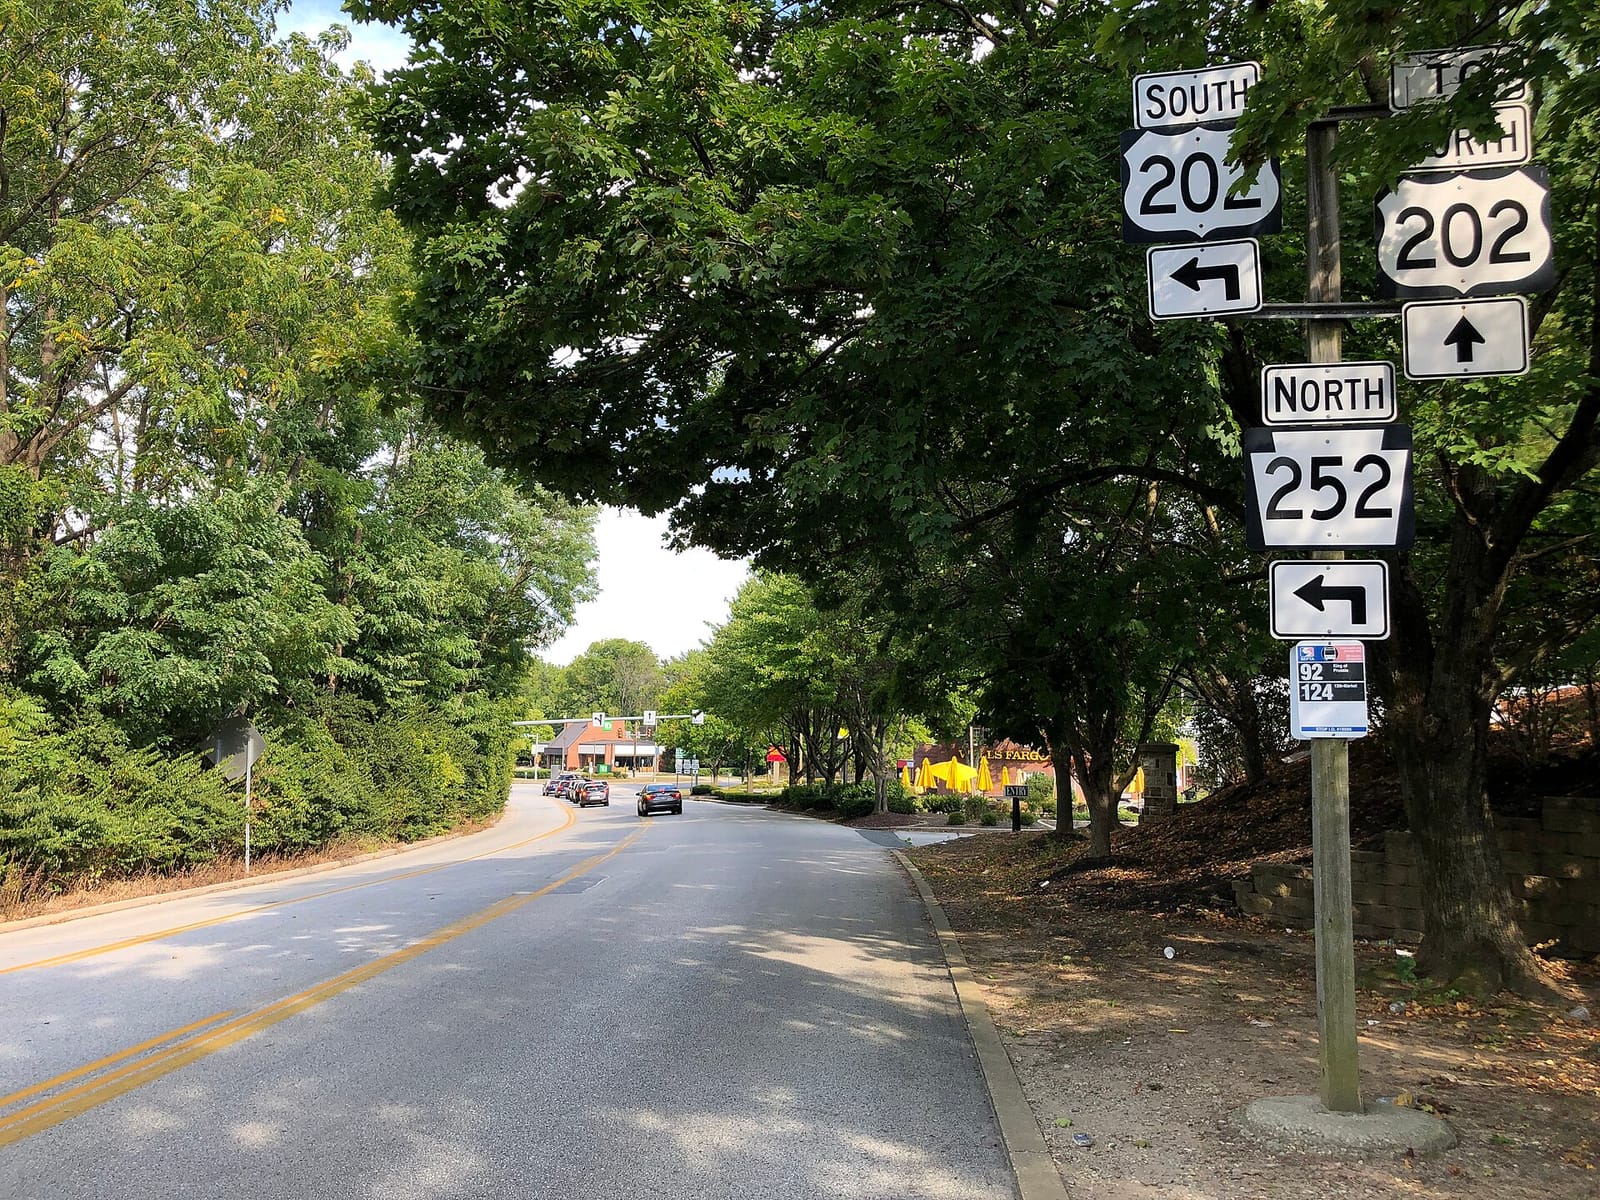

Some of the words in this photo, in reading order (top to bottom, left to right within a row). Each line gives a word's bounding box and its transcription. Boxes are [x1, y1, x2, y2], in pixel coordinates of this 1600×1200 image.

[1146, 78, 1249, 119] SOUTH
[1139, 151, 1262, 215] 202
[1395, 199, 1530, 271] 202
[1274, 376, 1385, 413] NORTH
[1265, 454, 1393, 521] 252
[1300, 664, 1323, 681] 92
[1301, 684, 1333, 700] 124
[1006, 786, 1026, 796] ENTRY
